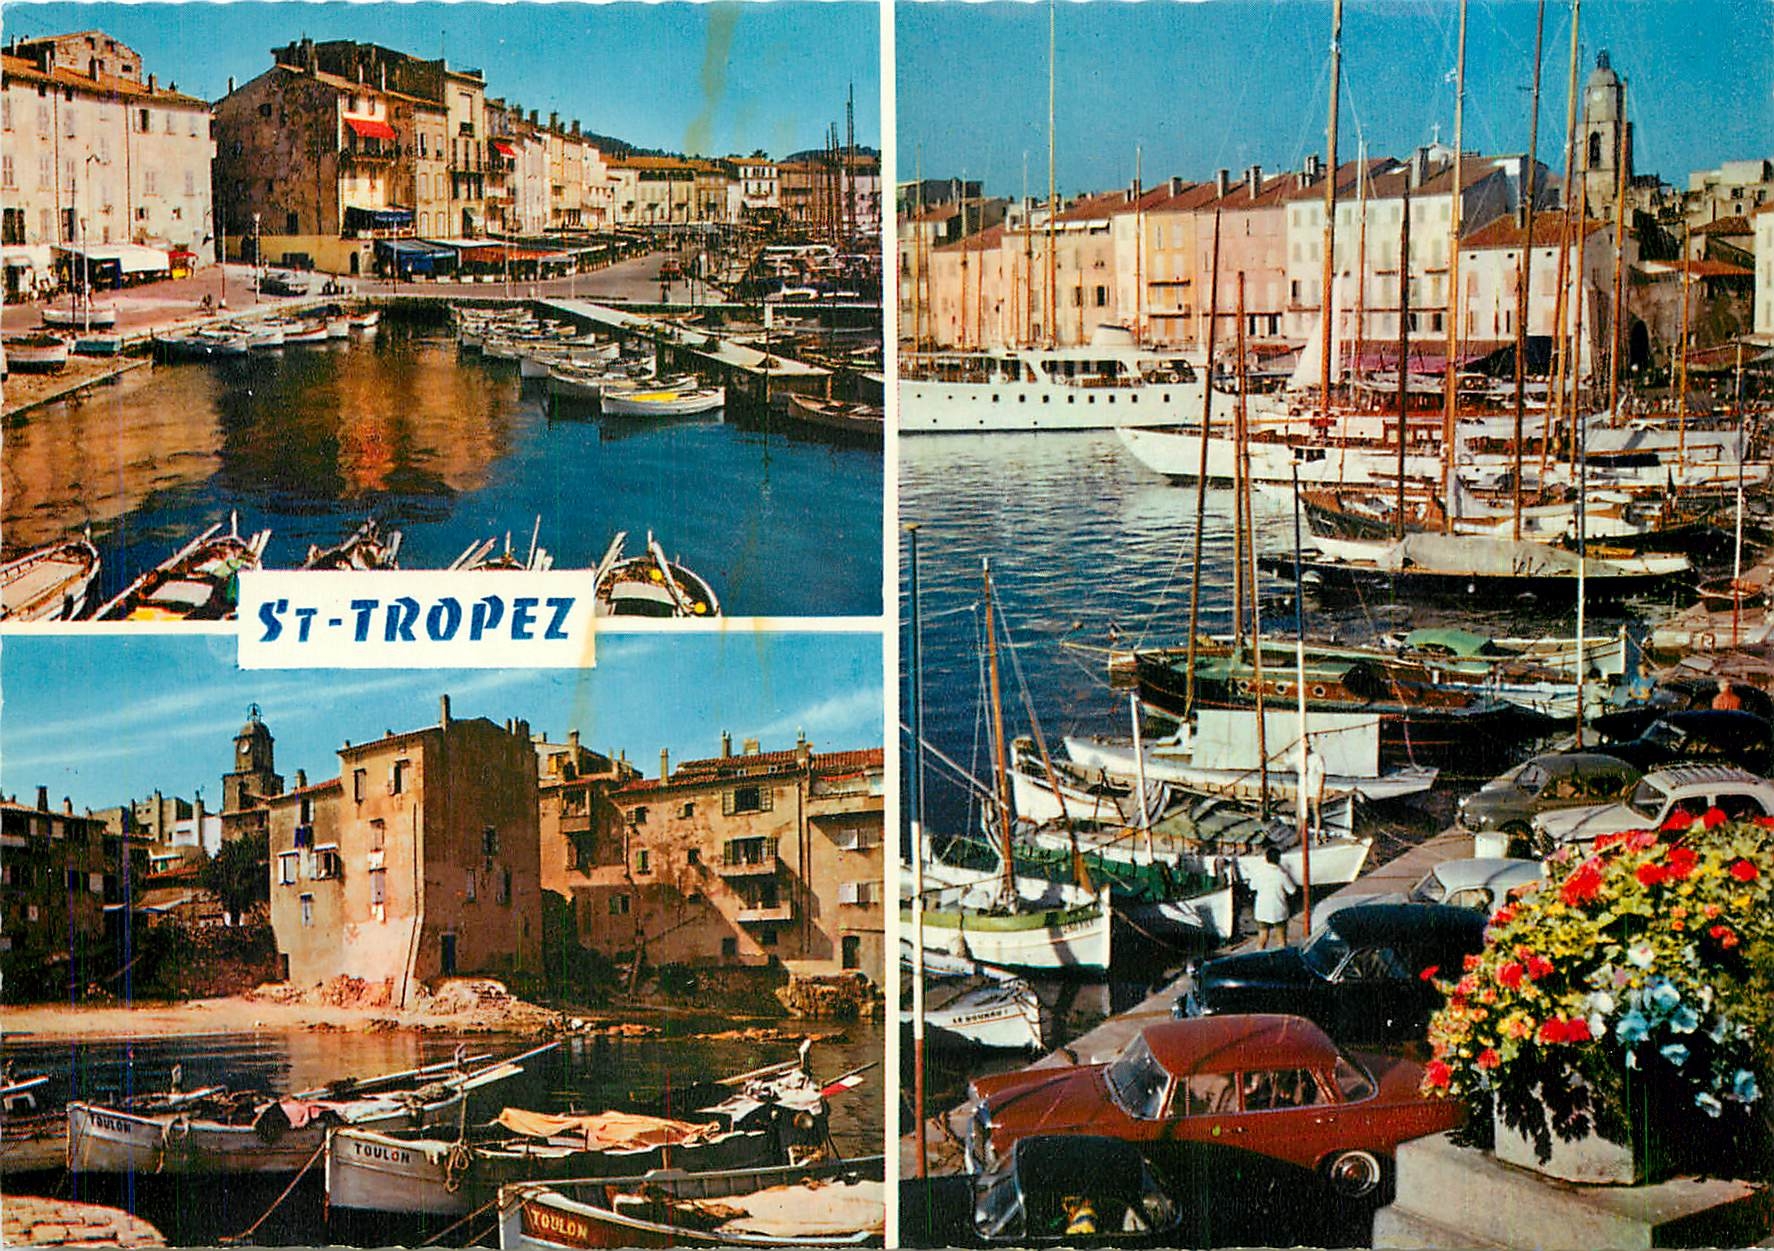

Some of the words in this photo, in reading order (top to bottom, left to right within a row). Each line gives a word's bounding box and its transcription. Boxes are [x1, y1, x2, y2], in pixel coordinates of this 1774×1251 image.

[90, 1113, 131, 1134] TOULON
[353, 1142, 410, 1163] TOULON
[531, 1208, 588, 1238] TOULON
